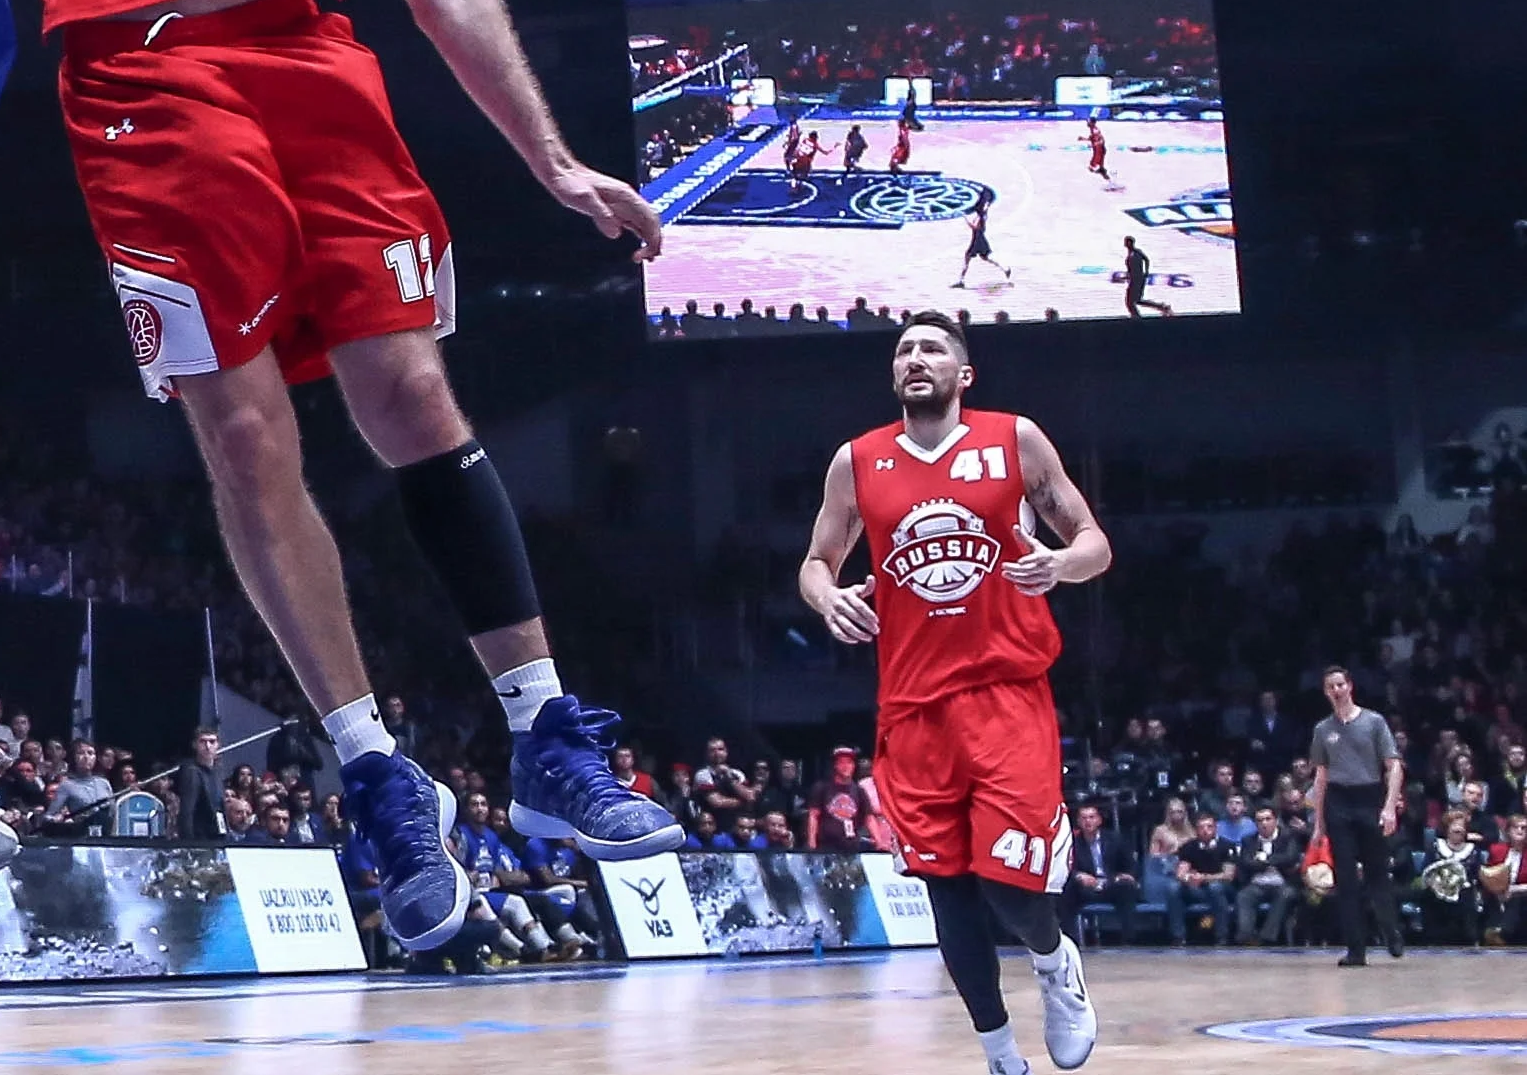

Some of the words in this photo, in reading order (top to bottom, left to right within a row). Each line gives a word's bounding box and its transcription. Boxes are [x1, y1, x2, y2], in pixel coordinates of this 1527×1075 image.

[949, 445, 1008, 483] 41
[895, 539, 990, 576] RUSSIA
[991, 828, 1046, 876] 41
[267, 914, 275, 934] 8
[276, 914, 295, 934] 800
[296, 914, 314, 933] 100
[315, 914, 328, 933] 00
